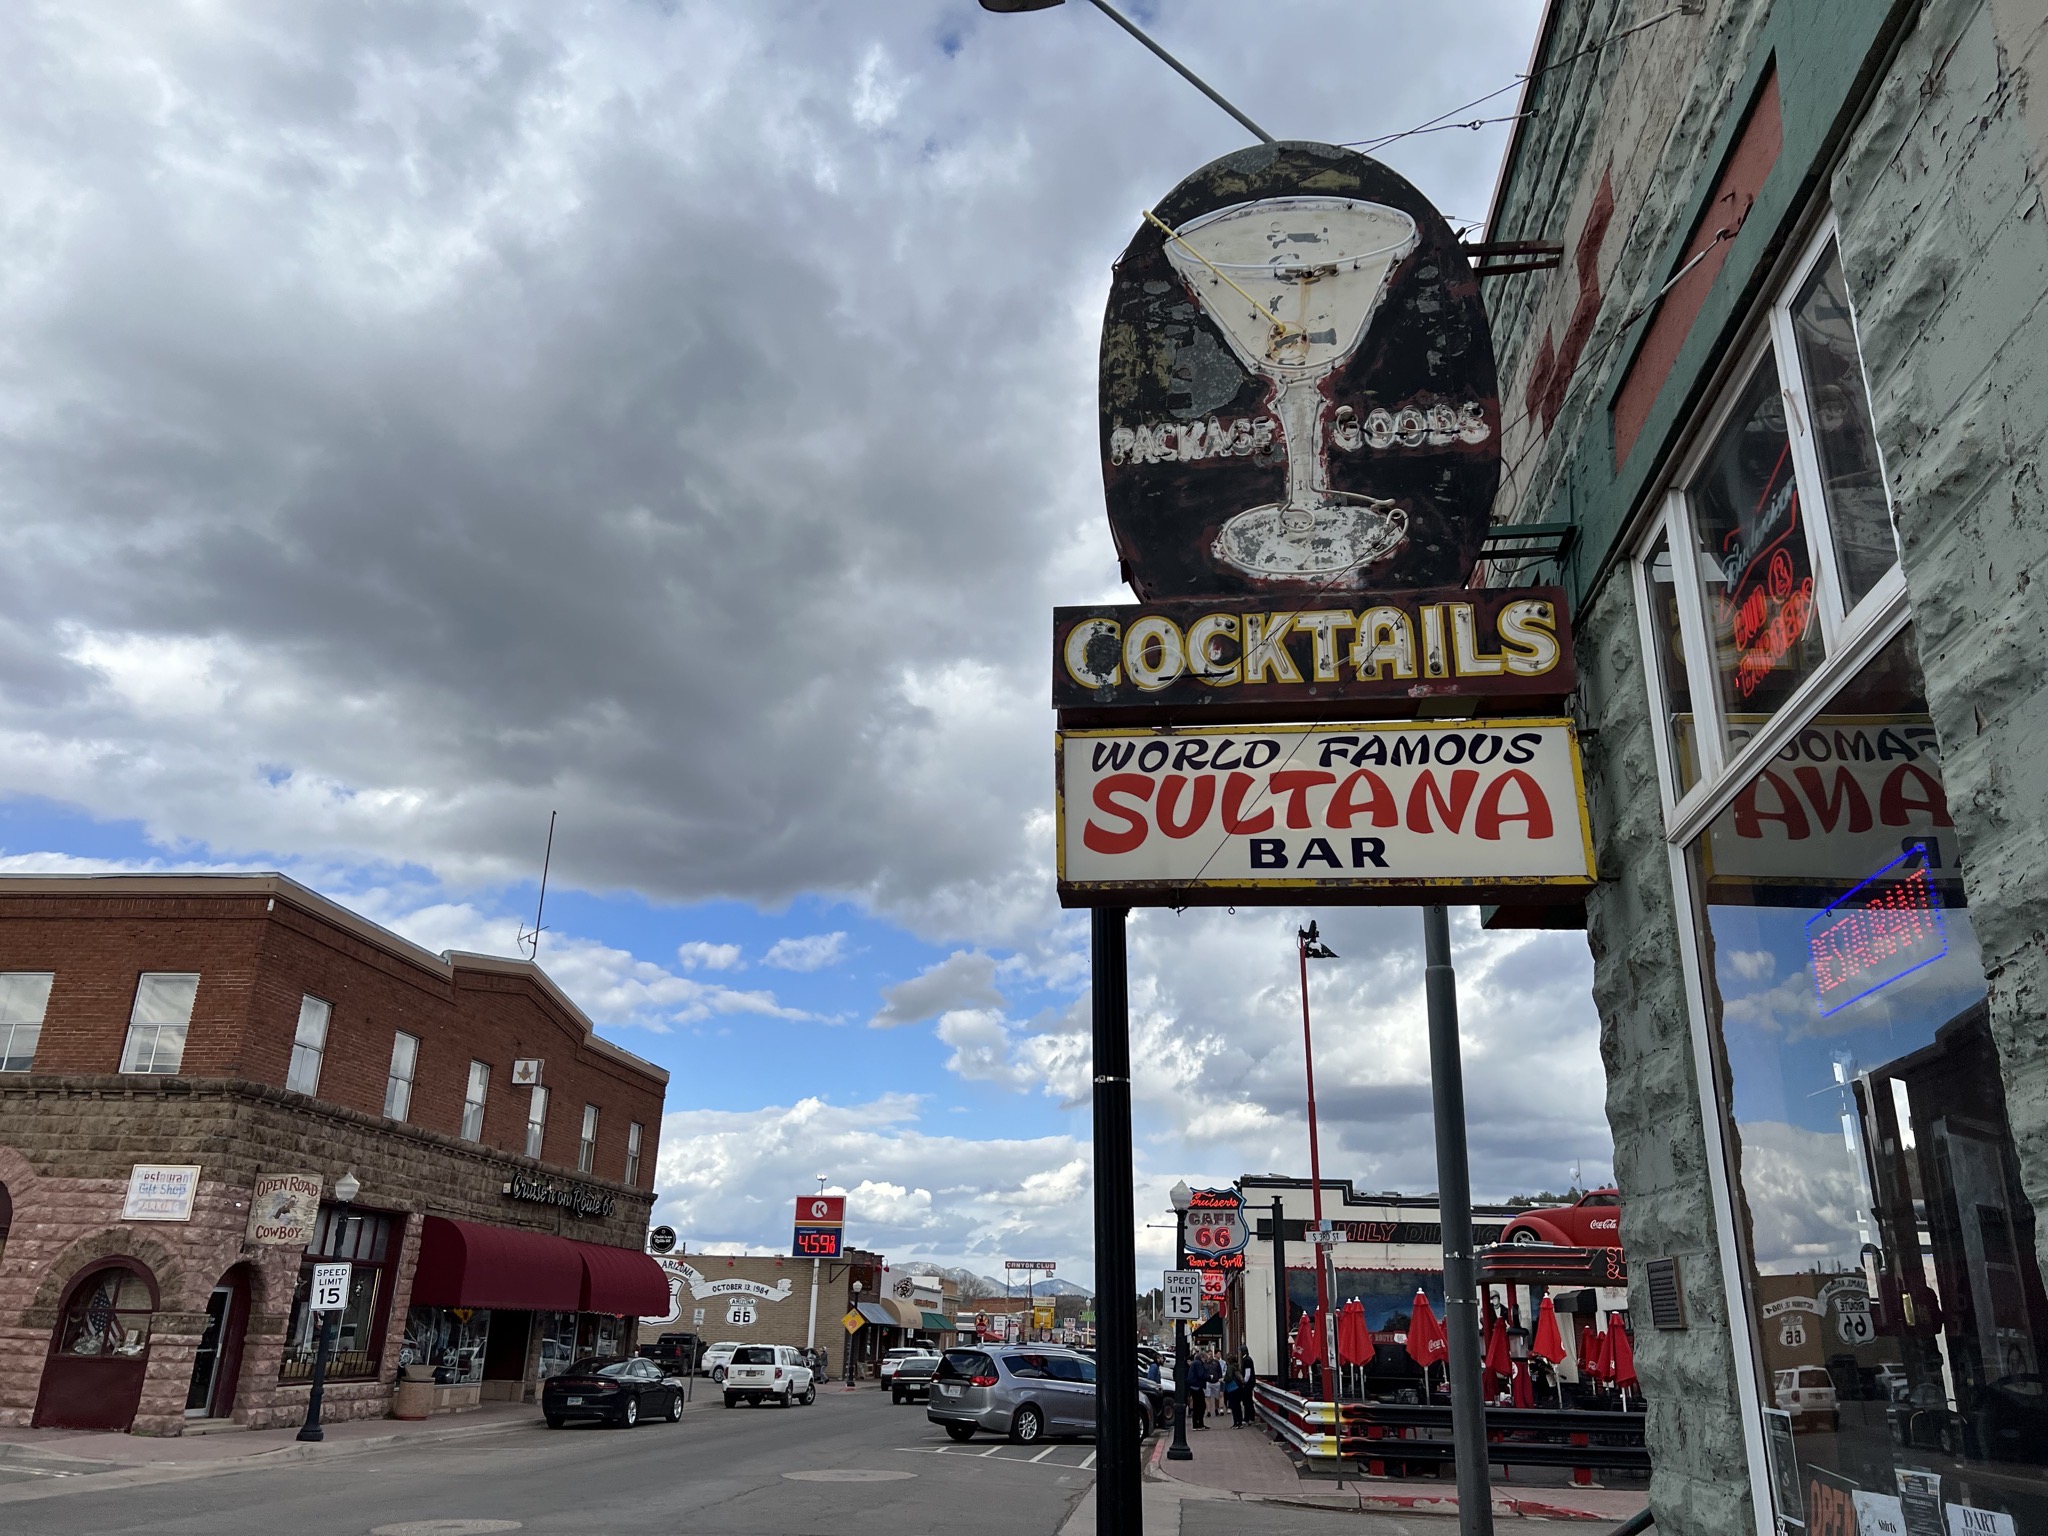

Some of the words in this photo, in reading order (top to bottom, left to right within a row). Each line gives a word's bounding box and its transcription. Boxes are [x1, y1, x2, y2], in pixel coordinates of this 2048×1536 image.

[1110, 416, 1276, 466] PACKAGE
[1333, 402, 1492, 453] GOODS
[1064, 599, 1560, 690] COCKTAILS
[1092, 738, 1281, 772] WORLD
[1318, 733, 1543, 767] FAMOUS
[1083, 768, 1554, 855] SULTANA
[1249, 837, 1391, 868] BAR
[139, 1183, 157, 1197] Gift
[160, 1183, 187, 1198] Shop
[257, 1178, 288, 1197] OPEN
[289, 1176, 319, 1197] ROAD
[136, 1200, 180, 1211] PARKING
[573, 1187, 602, 1218] Route
[602, 1194, 616, 1217] 66
[815, 1204, 825, 1216] K
[1188, 1213, 1236, 1226] CAFE
[1194, 1226, 1232, 1248] 66
[1319, 1233, 1331, 1241] 3RD
[1333, 1233, 1340, 1241] ST
[661, 1260, 694, 1278] ARIZONA
[1186, 1254, 1206, 1267] Bar
[1220, 1254, 1244, 1268] Grill
[319, 1278, 343, 1286] LIMIT
[1167, 1276, 1197, 1285] SPEED
[1205, 1281, 1222, 1292] 66
[319, 1288, 340, 1305] 15
[712, 1283, 742, 1293] OCTOBER
[753, 1285, 770, 1296] 1984
[1170, 1286, 1194, 1294] LIMIT
[1171, 1296, 1193, 1314] 15
[733, 1311, 751, 1323] 66
[1877, 1518, 1898, 1534] Shirts
[1962, 1509, 1998, 1533] DART
